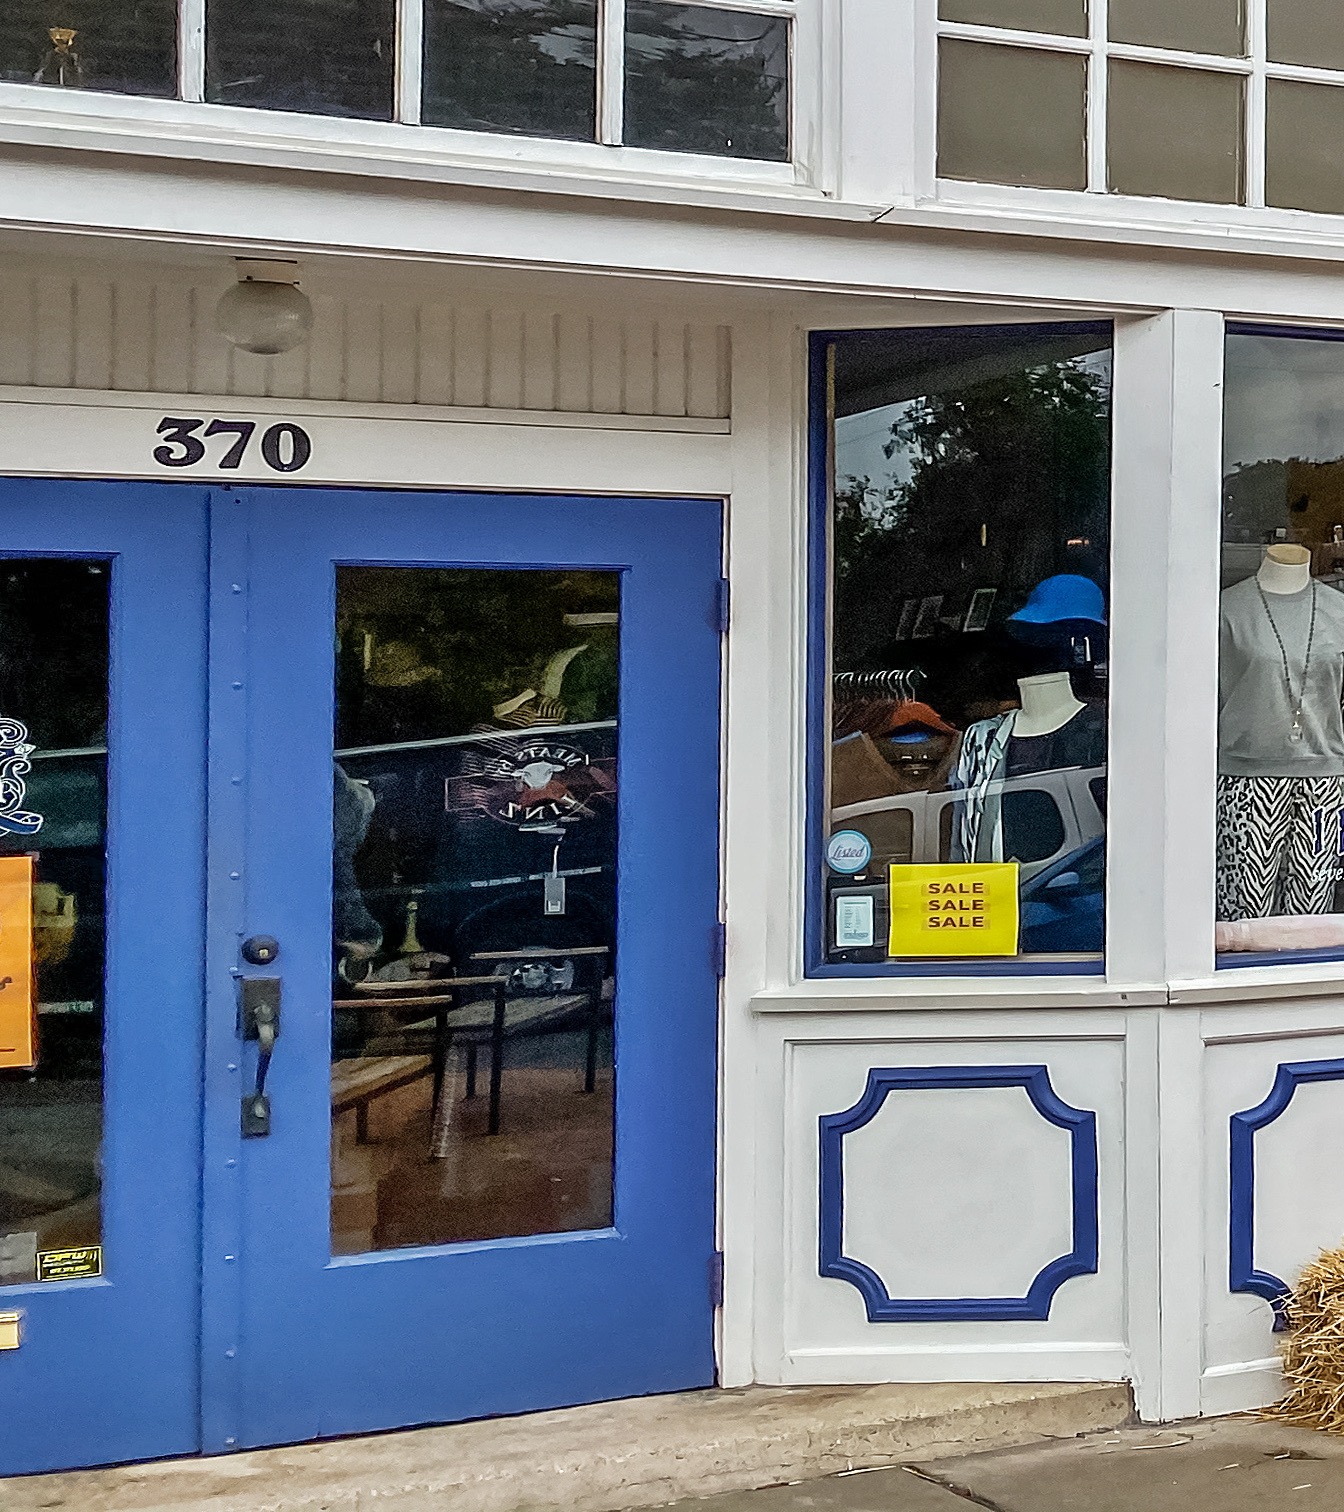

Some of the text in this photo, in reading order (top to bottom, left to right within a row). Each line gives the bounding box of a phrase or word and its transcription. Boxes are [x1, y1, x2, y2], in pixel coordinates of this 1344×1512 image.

[153, 416, 312, 473] 370
[830, 843, 867, 861] Listed
[928, 882, 985, 894] SALE
[928, 899, 985, 911] SALE
[928, 916, 985, 928] SALE
